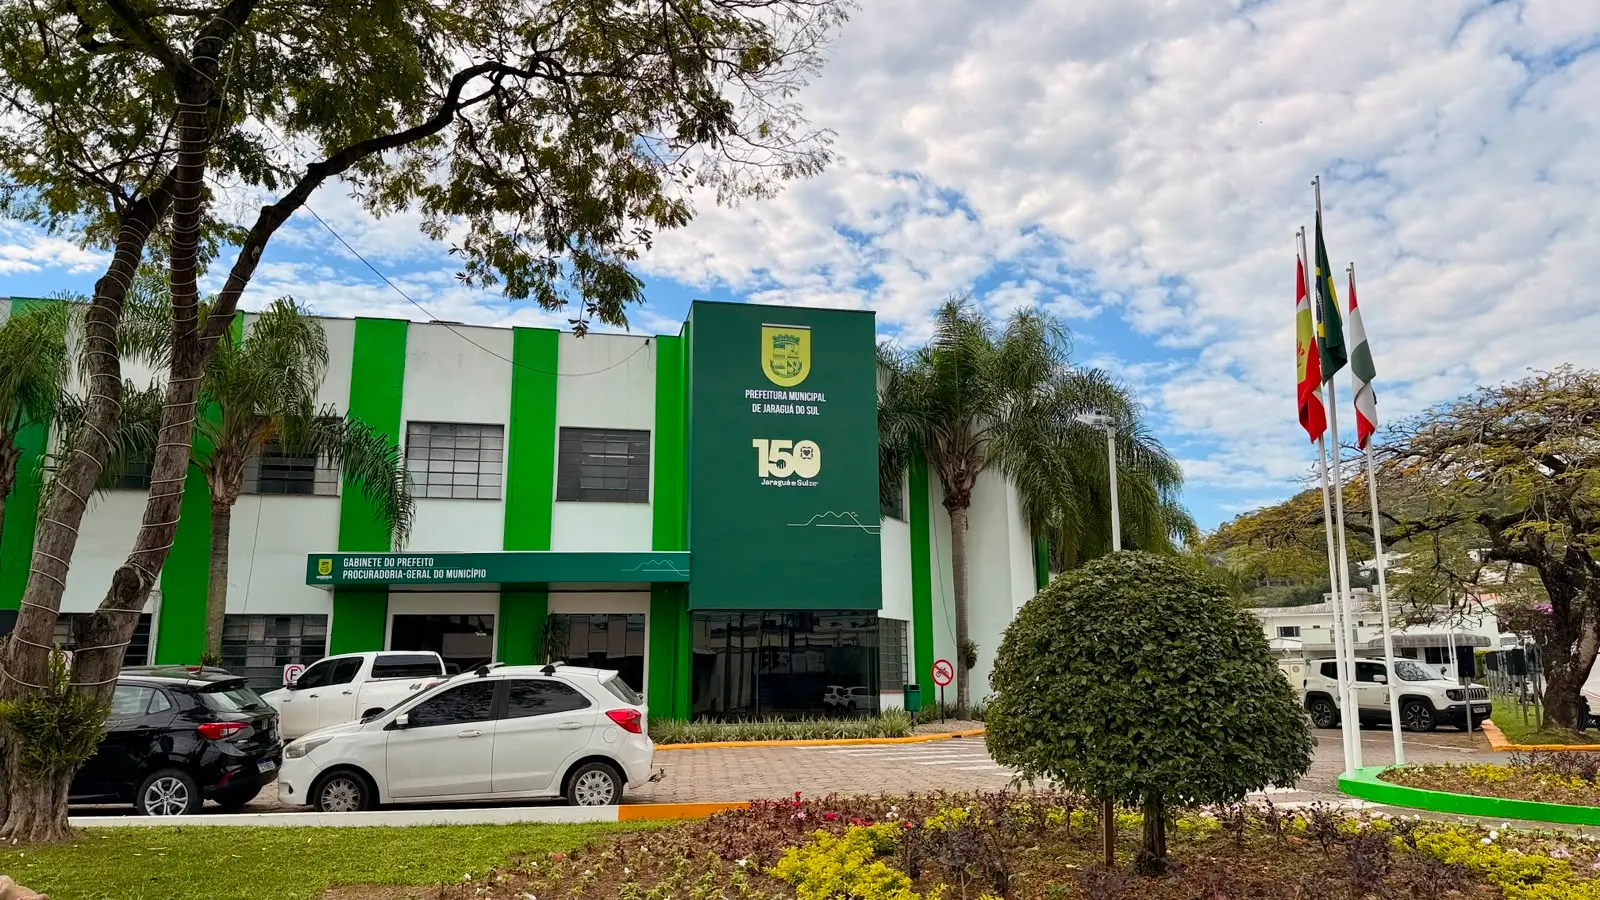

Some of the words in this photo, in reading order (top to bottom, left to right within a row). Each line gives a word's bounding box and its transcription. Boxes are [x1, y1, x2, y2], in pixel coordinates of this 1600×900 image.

[745, 389, 787, 400] PREFEITURA
[788, 391, 826, 402] MUNICIPAL
[752, 403, 761, 413] DE
[763, 403, 794, 414] JARAGUÁ
[795, 405, 805, 415] DO
[806, 406, 820, 416] SUL
[752, 438, 821, 479] 150
[760, 478, 790, 487] Jaraguá
[796, 479, 809, 487] Sul
[343, 557, 382, 567] GABINETE
[384, 557, 395, 567] DO
[396, 557, 434, 567] PREFEITO
[342, 569, 431, 580] PROCURADORIA-GERAL
[433, 569, 444, 579] DO
[445, 568, 486, 579] MUNICÍPIO
